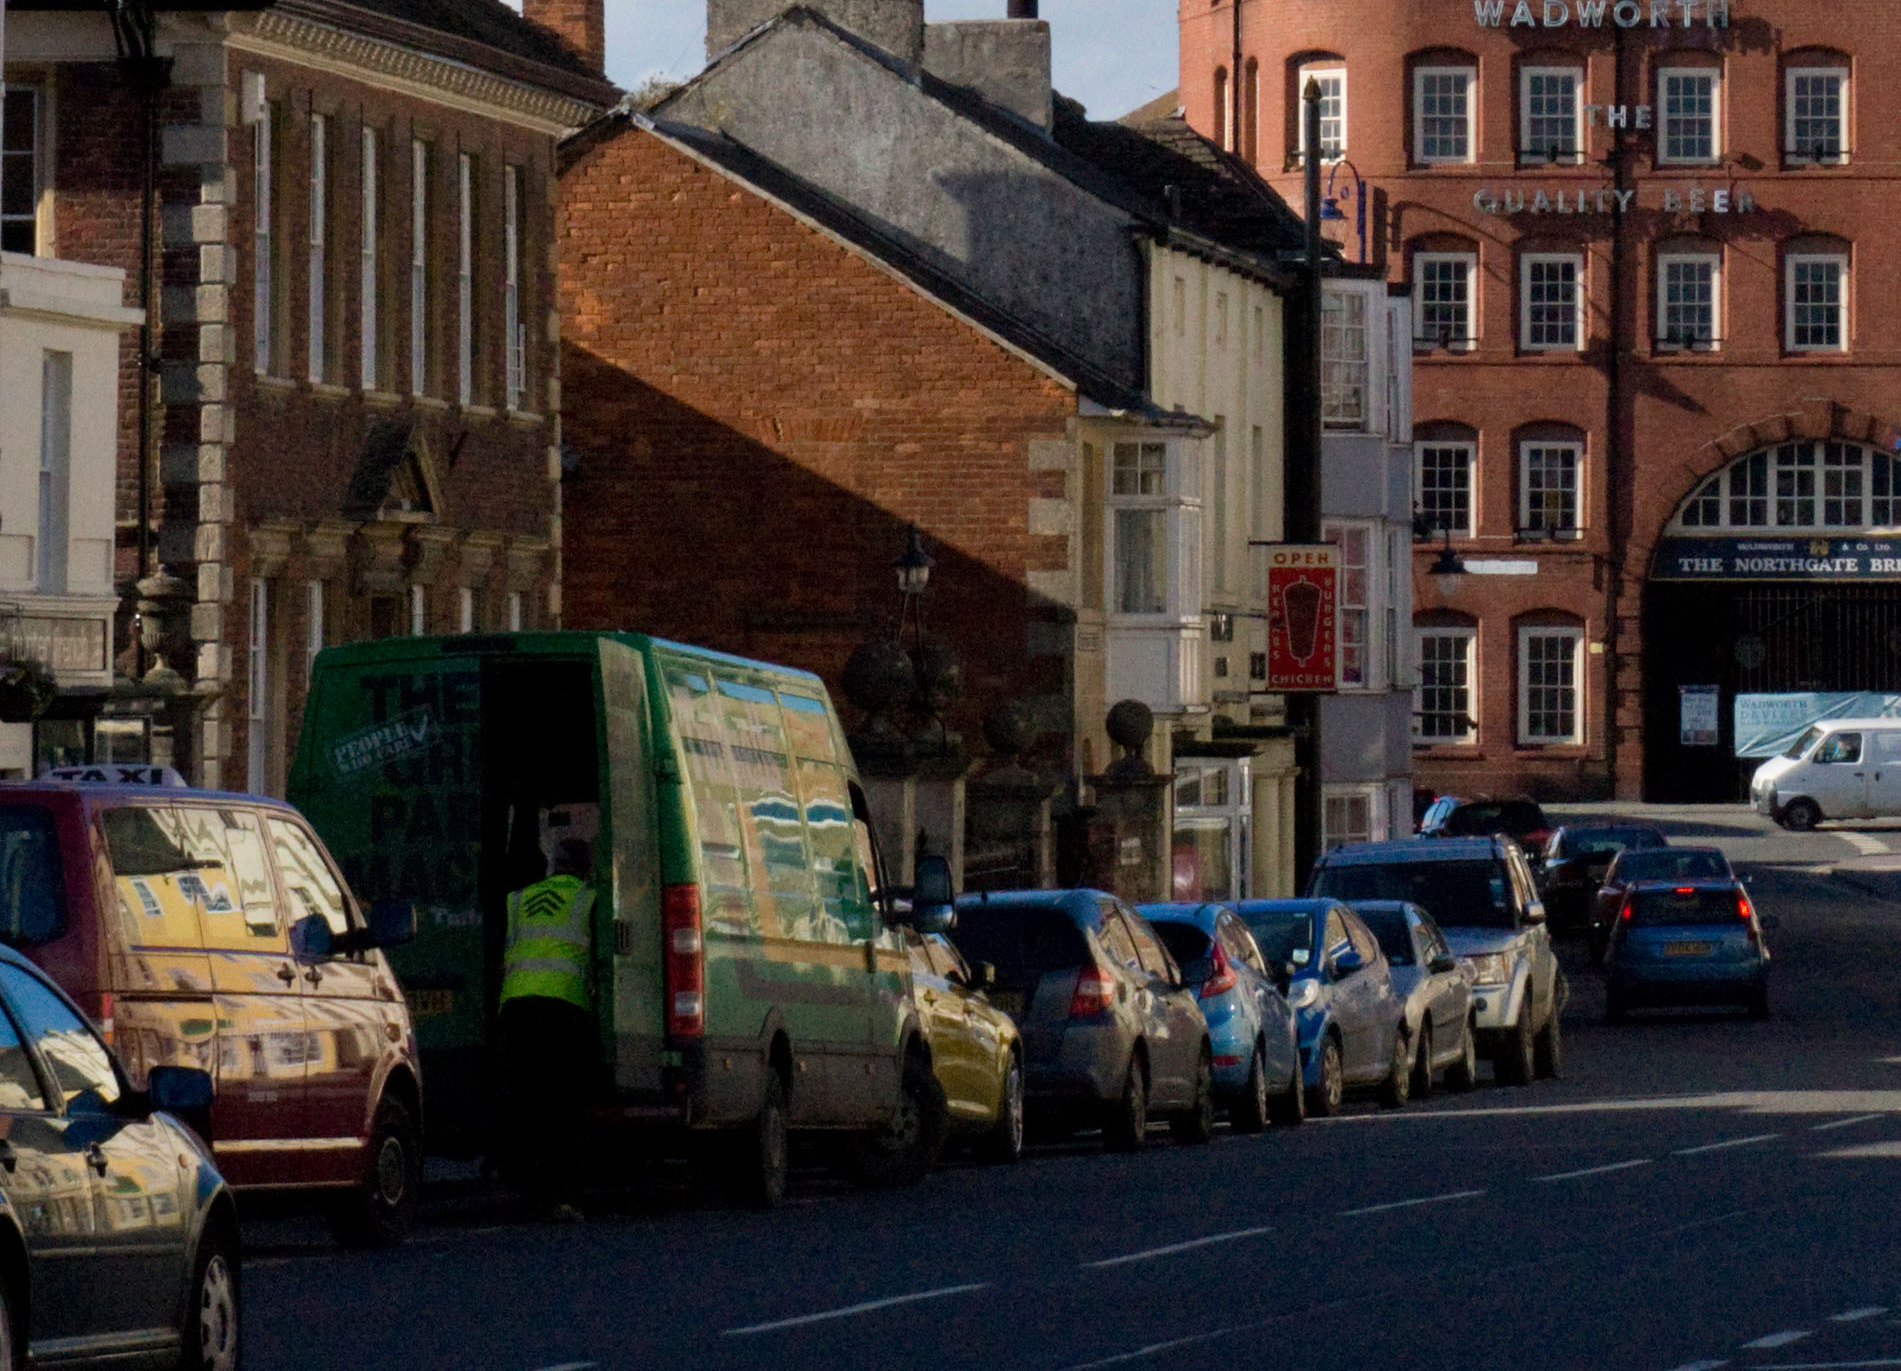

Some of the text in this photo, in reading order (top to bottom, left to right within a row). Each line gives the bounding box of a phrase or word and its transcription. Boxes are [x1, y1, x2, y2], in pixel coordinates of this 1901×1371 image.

[1583, 104, 1652, 129] THE
[1473, 188, 1754, 214] QUALITY BEER
[1273, 552, 1329, 565] OPEN
[1679, 556, 1724, 573] THE
[1735, 556, 1859, 573] NORTHGATE
[1323, 577, 1333, 667] BURGERS
[1271, 673, 1333, 685] CHICKEN
[52, 768, 163, 785] TAXI
